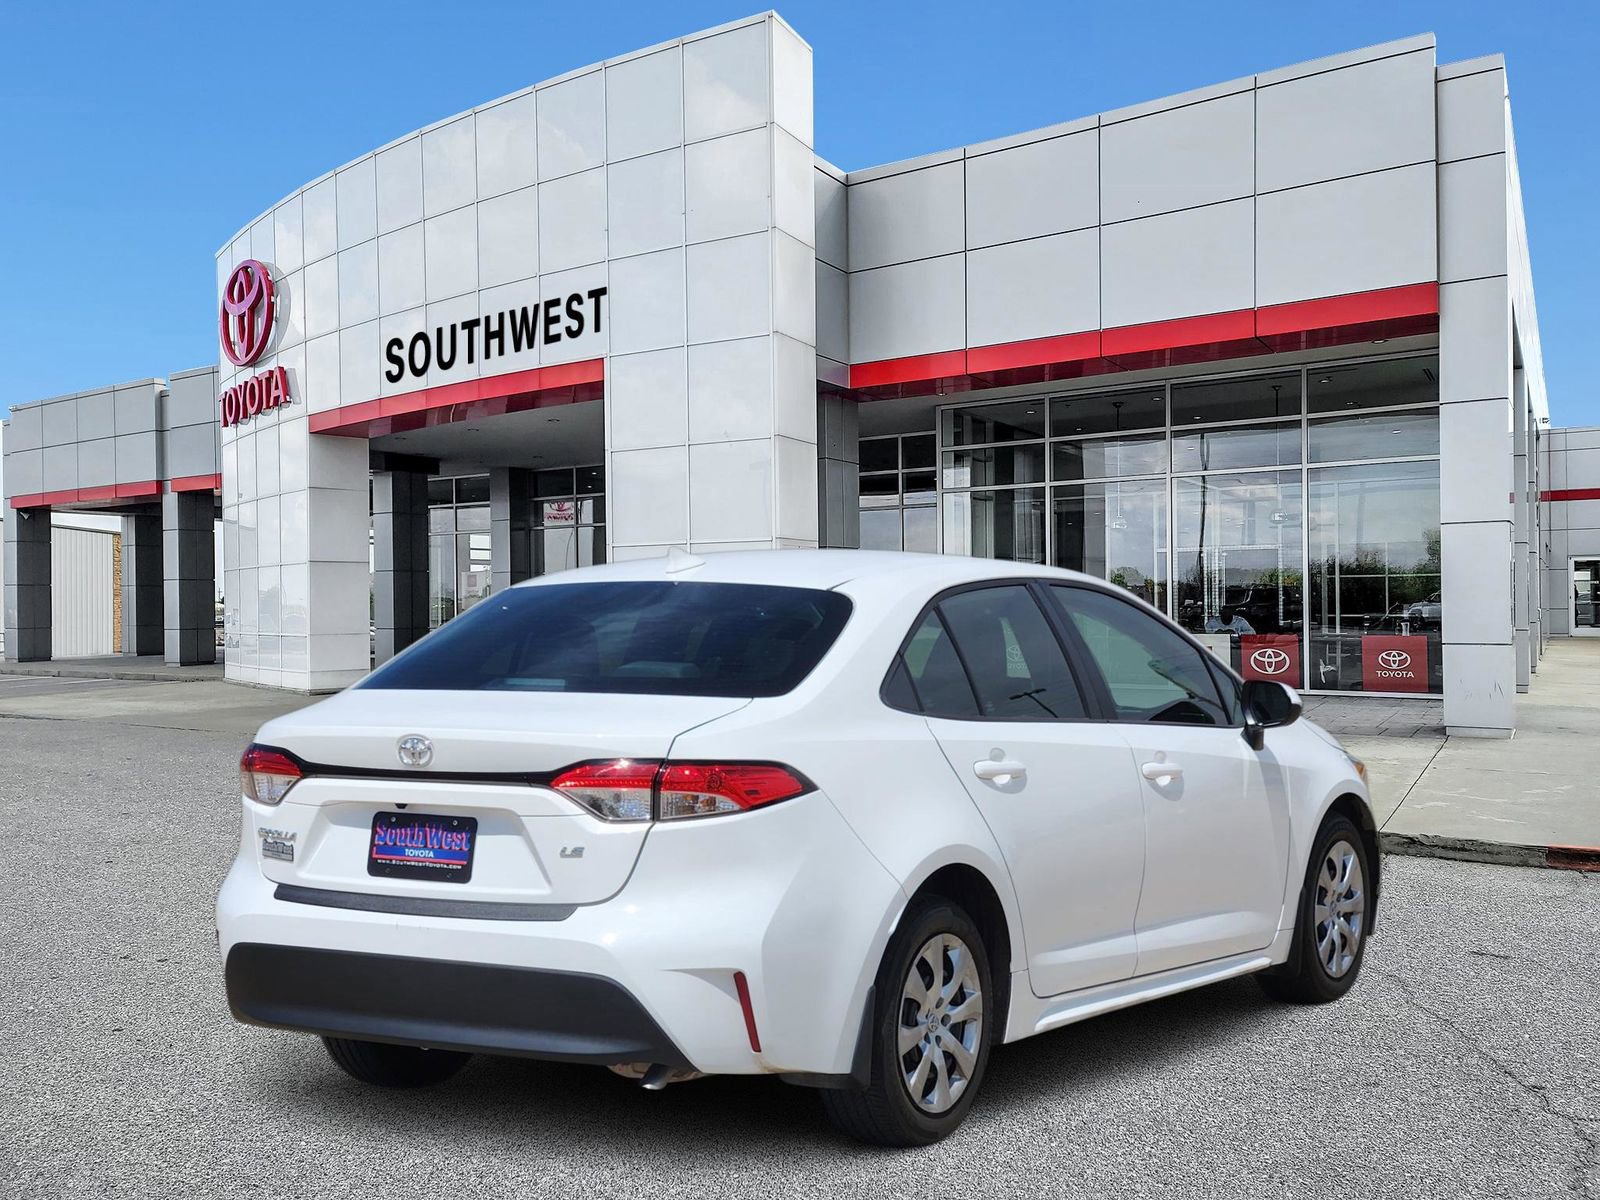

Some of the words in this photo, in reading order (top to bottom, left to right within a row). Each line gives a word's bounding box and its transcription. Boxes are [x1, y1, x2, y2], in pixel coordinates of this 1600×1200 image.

[385, 287, 607, 383] SOUTHWEST
[219, 366, 291, 427] TOYOTA
[1376, 670, 1415, 678] TOYOTA
[405, 848, 434, 858] TOYOTA
[560, 846, 584, 858] LE
